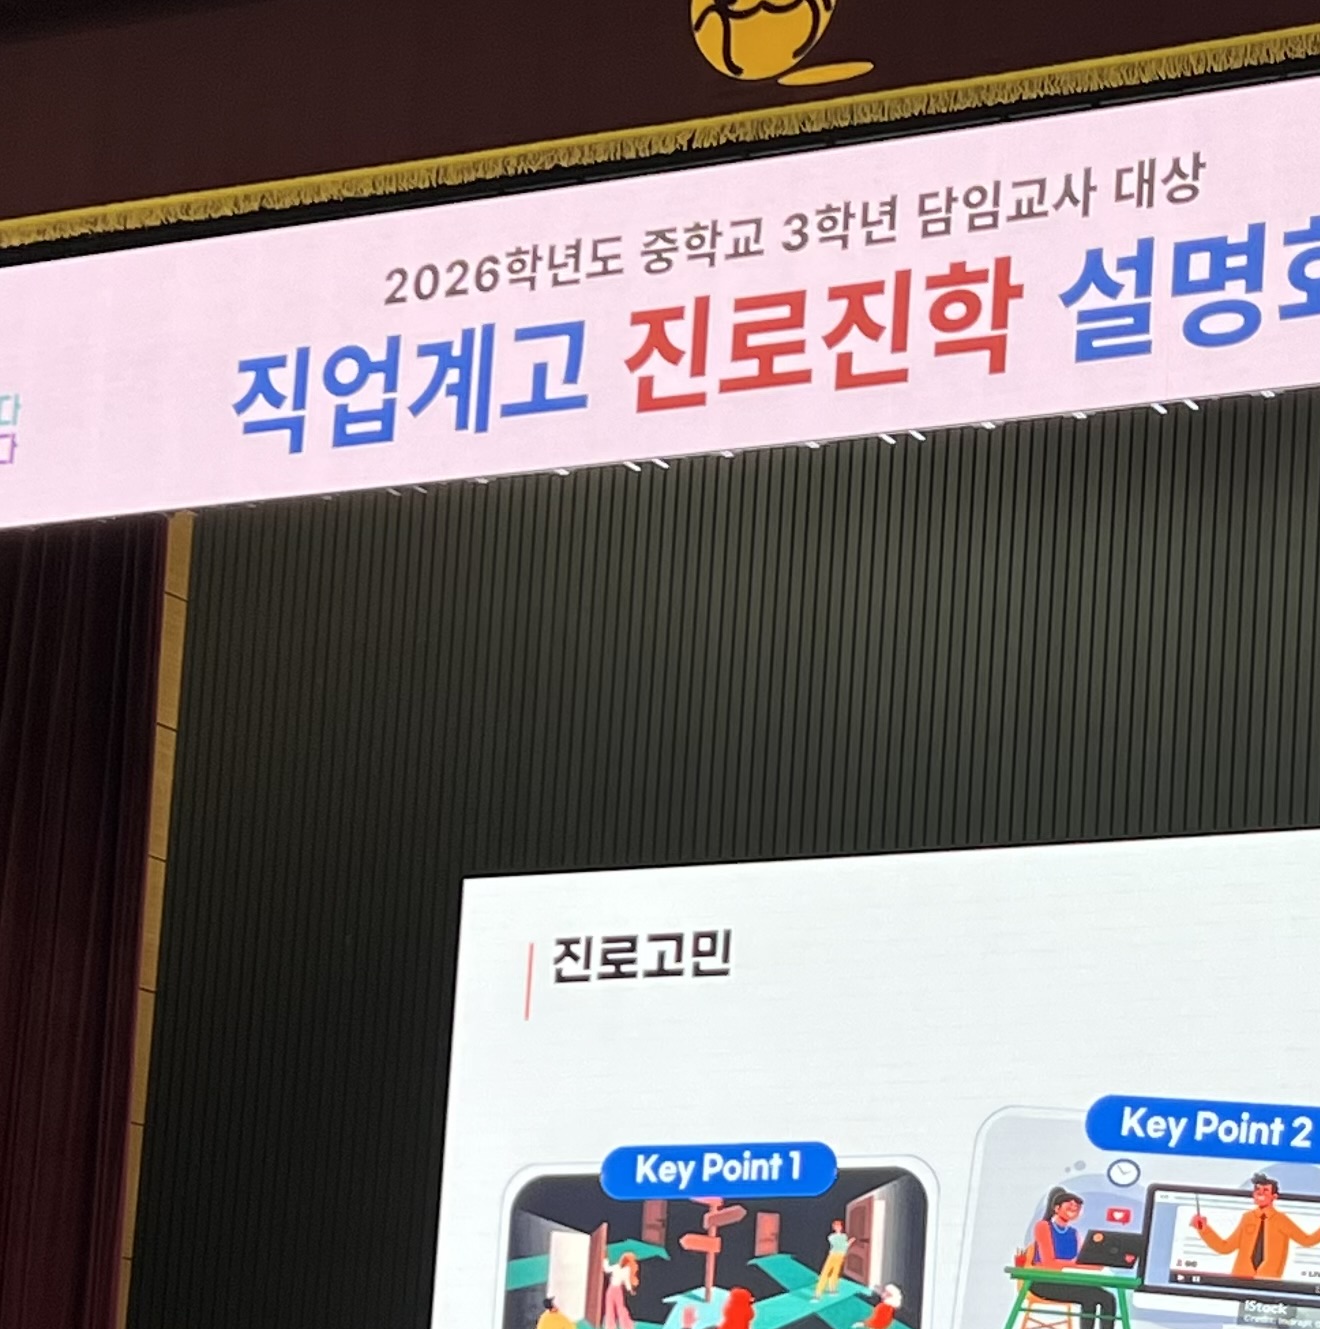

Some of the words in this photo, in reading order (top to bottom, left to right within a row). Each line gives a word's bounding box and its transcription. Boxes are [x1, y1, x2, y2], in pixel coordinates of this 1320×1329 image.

[385, 235, 625, 306] 2026학년도
[640, 216, 765, 275] 중학교
[782, 194, 898, 252] 3학년
[918, 167, 1097, 240] 담임교사
[1113, 151, 1207, 210] 대상
[232, 319, 589, 456] 직업계고
[624, 256, 1024, 414] 진로진학
[553, 929, 733, 985] 진로고민
[1120, 1105, 1190, 1149] Key
[1195, 1111, 1287, 1148] Point
[1292, 1116, 1314, 1149] 2
[635, 1154, 696, 1191] Key
[702, 1151, 784, 1184] Point
[788, 1151, 801, 1181] 1
